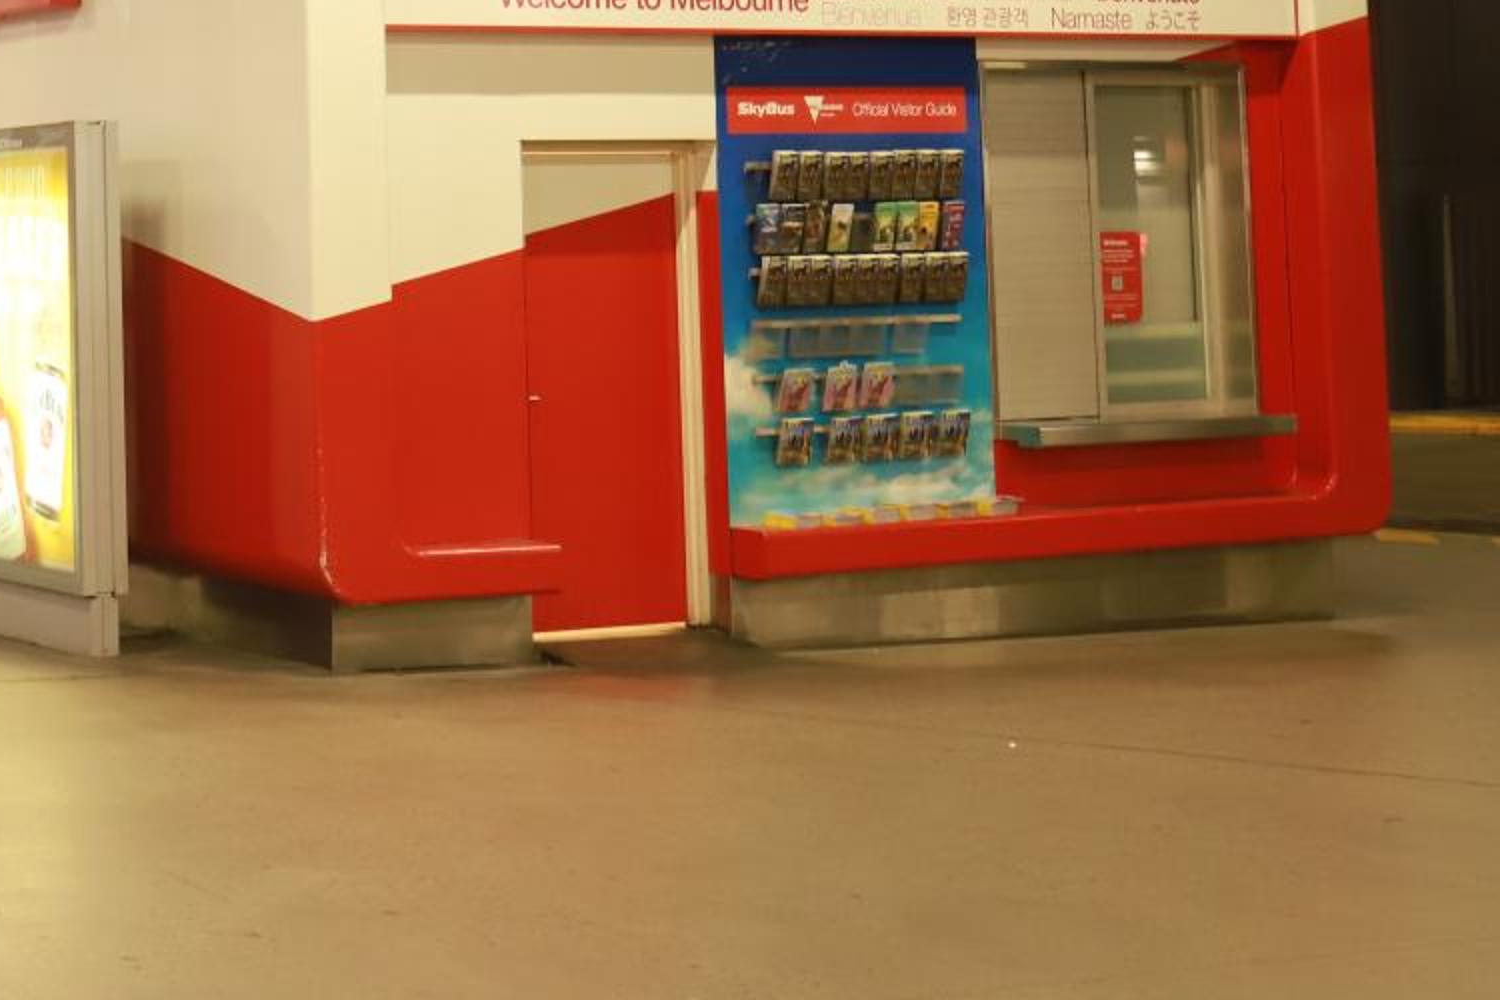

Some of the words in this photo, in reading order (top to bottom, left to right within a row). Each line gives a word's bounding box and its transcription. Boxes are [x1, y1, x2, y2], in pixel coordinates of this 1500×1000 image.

[1051, 7, 1132, 30] Namaste
[1145, 9, 1200, 31] ようこそ
[925, 103, 957, 117] Guide
